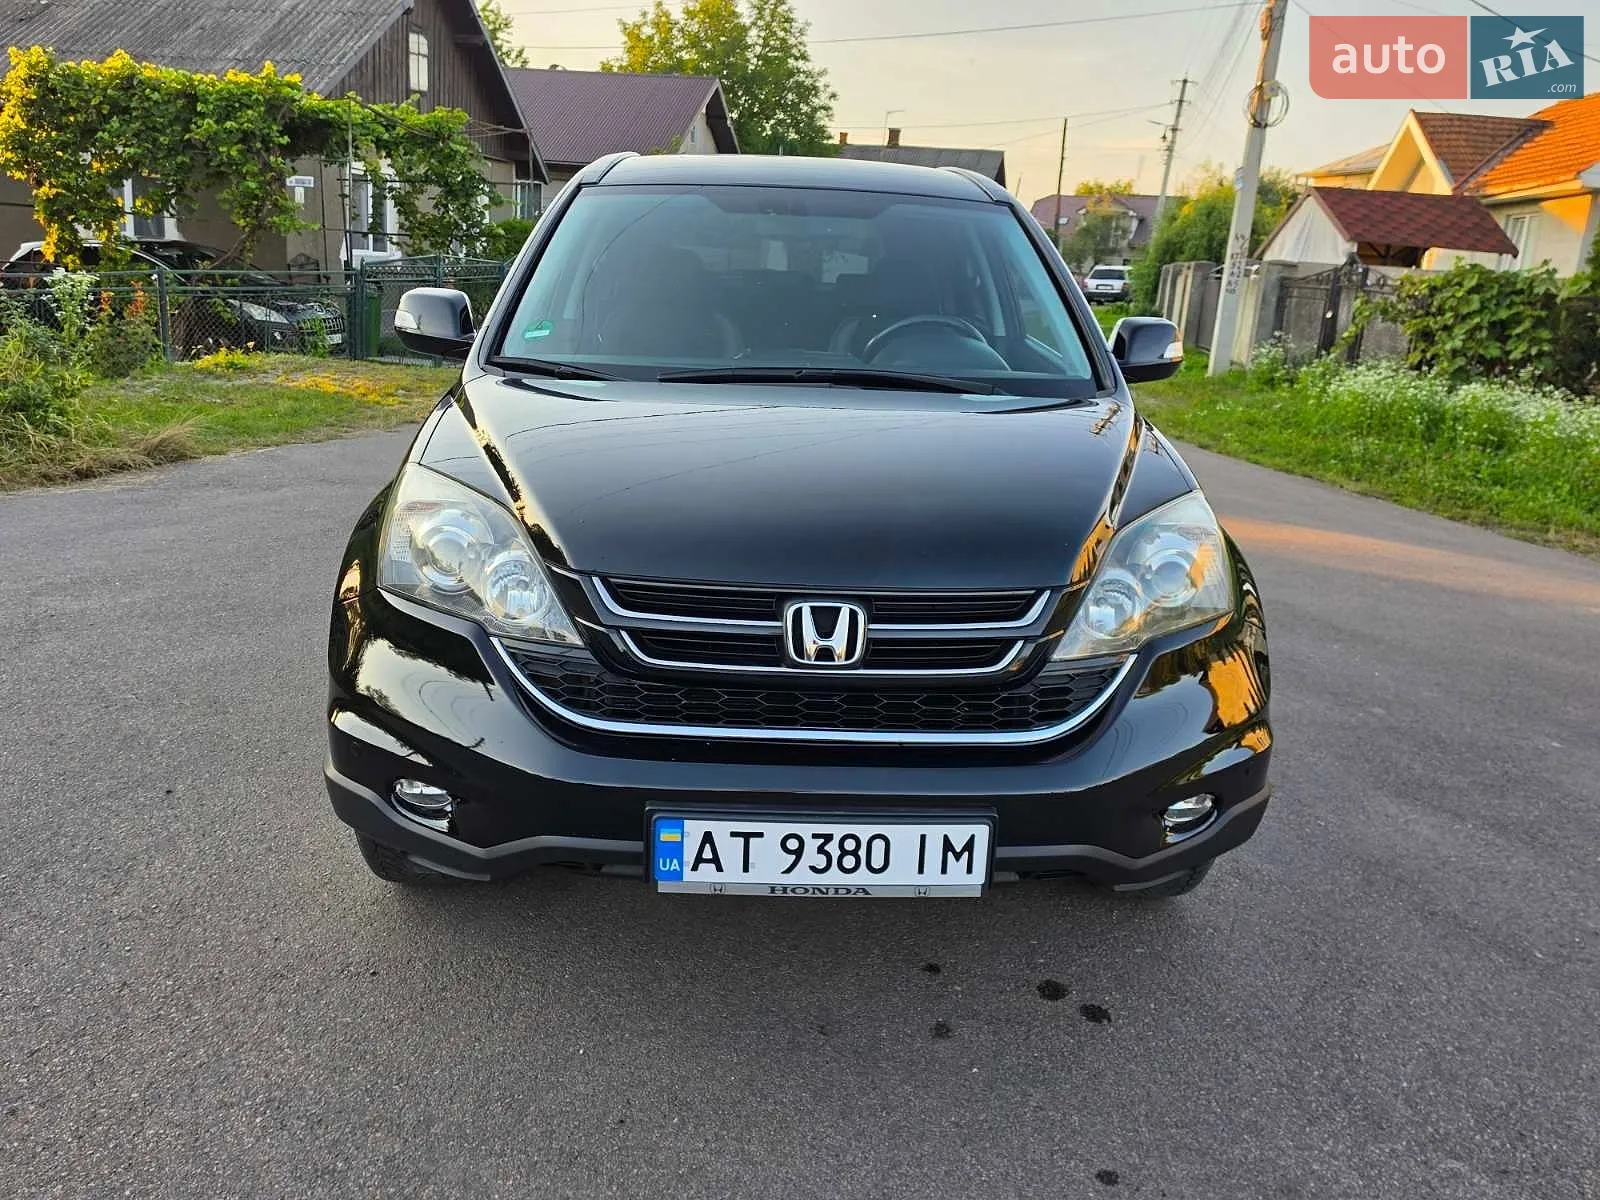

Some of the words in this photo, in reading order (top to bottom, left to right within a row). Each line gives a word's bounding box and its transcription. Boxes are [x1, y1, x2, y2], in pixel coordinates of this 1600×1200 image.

[690, 831, 764, 873] AT
[780, 832, 891, 875] 9380
[917, 834, 976, 875] IM
[660, 858, 680, 871] UA
[767, 885, 872, 896] HONDA
